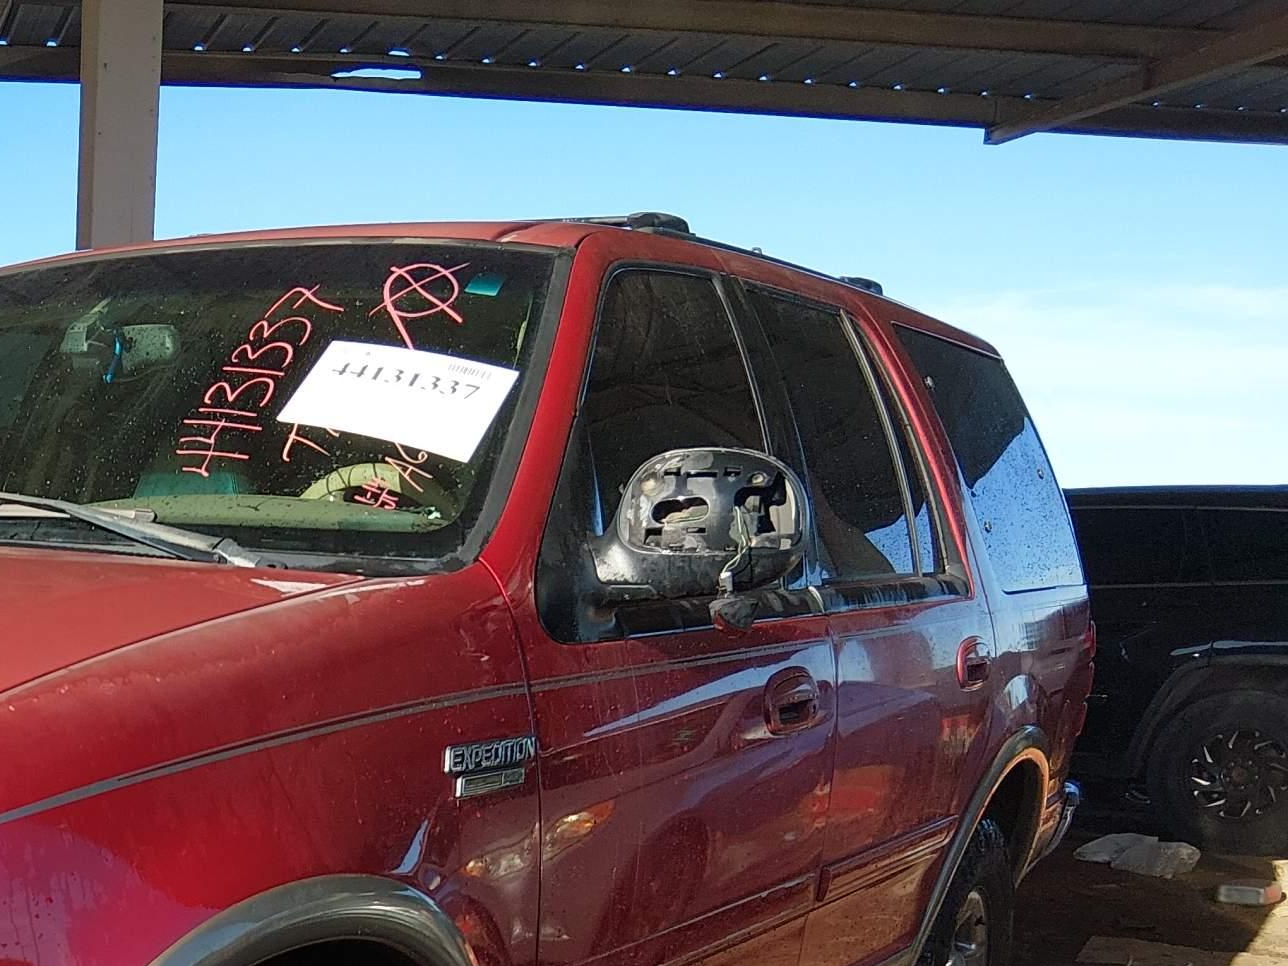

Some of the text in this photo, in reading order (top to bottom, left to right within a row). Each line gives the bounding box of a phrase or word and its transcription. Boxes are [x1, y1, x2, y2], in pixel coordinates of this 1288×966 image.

[176, 284, 344, 477] 44131337
[331, 362, 481, 400] 44131337
[450, 737, 536, 771] EXPEDITION
